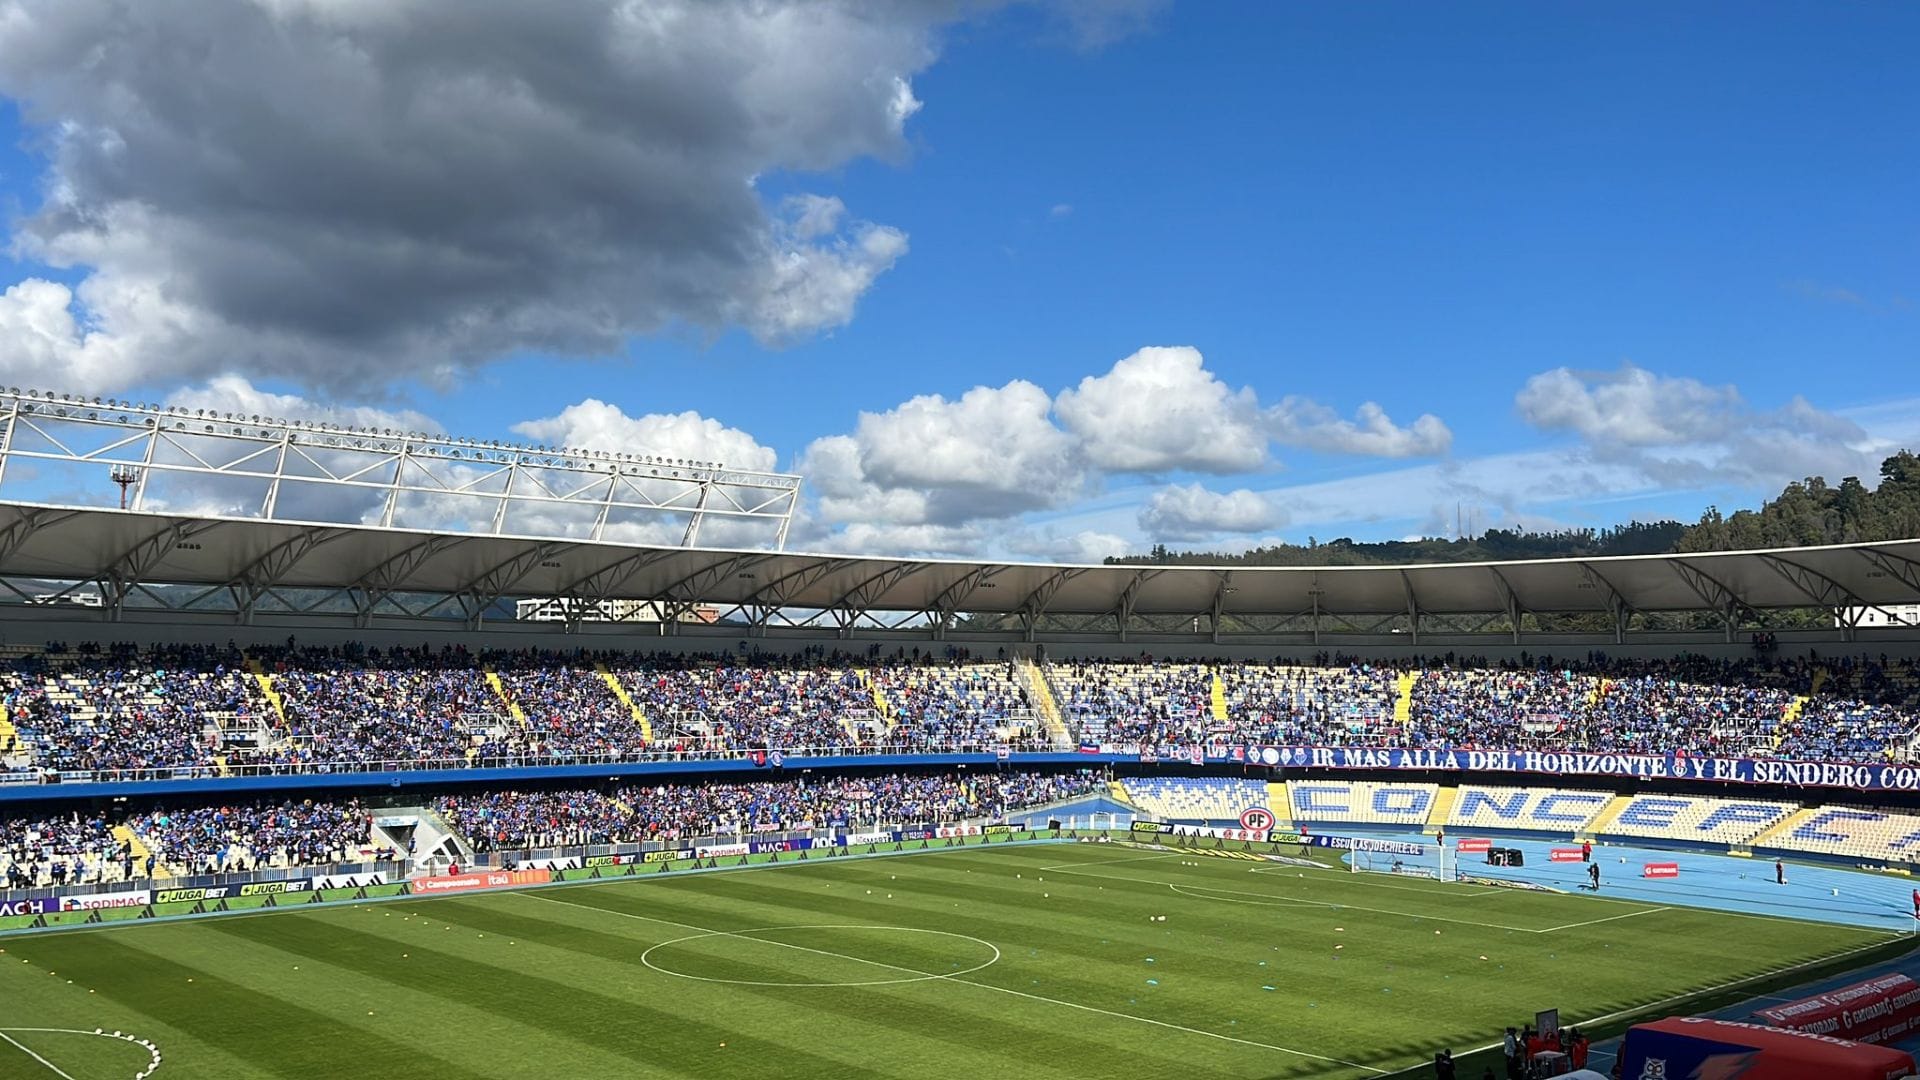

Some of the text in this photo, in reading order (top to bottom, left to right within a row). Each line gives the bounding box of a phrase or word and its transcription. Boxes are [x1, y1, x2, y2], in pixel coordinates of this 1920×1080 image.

[1312, 748, 1336, 767] IR
[1346, 748, 1390, 769] MAS
[1399, 748, 1458, 770] ALLA
[1469, 750, 1517, 771] DEL
[1525, 752, 1668, 777] HORIZONTE
[1693, 758, 1712, 777] Y
[1715, 758, 1747, 781] EL
[1753, 760, 1872, 788] SENDERO
[1248, 813, 1265, 828] PF
[595, 855, 636, 866] JUGBET
[654, 850, 693, 861] JUGABET
[171, 887, 228, 903] JUGABET
[253, 881, 307, 896] JUGABET
[83, 896, 145, 910] SODIMAC
